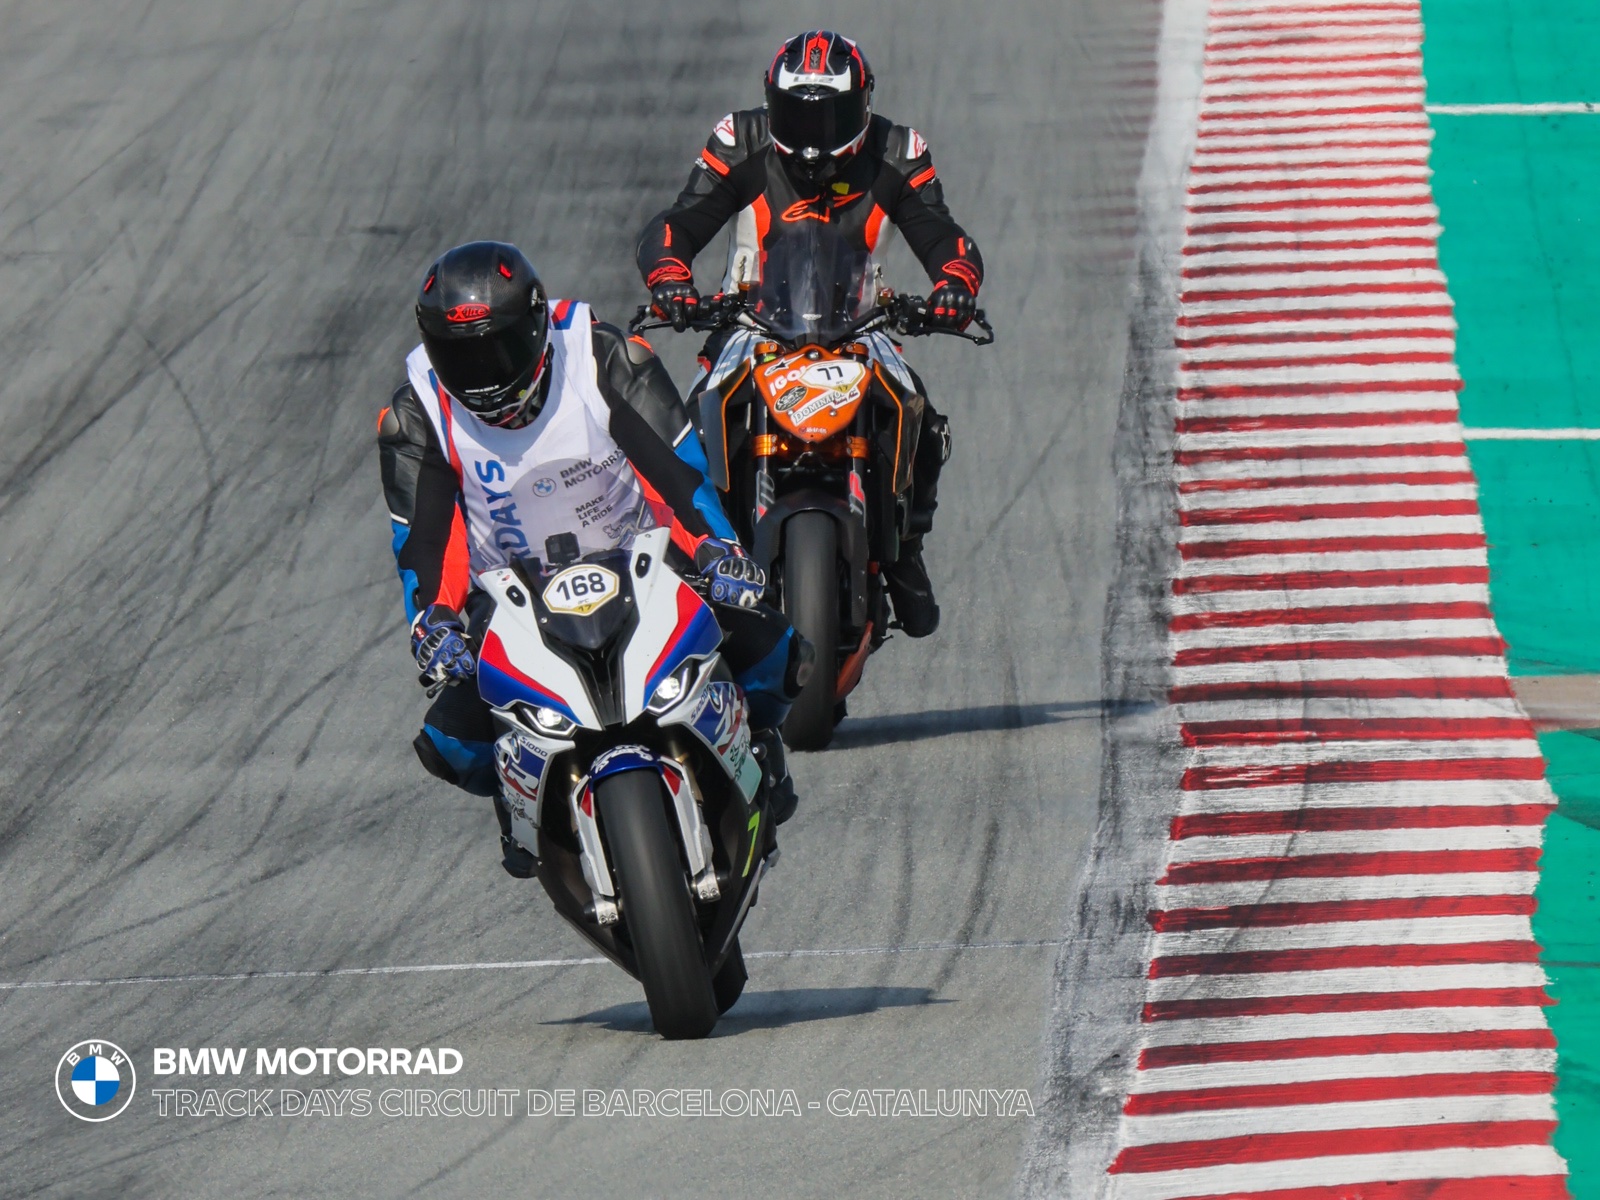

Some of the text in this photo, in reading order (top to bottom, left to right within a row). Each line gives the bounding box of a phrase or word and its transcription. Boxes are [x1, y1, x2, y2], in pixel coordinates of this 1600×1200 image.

[817, 365, 843, 380] 77
[793, 391, 845, 424] DOMINATO
[560, 458, 592, 479] BMW
[564, 444, 622, 488] MOTORRA
[475, 459, 531, 560] DAYS
[575, 495, 604, 513] MAKE
[578, 506, 600, 520] LIFE
[591, 504, 613, 522] RIDE
[556, 572, 606, 601] 168
[519, 736, 548, 758] S1000
